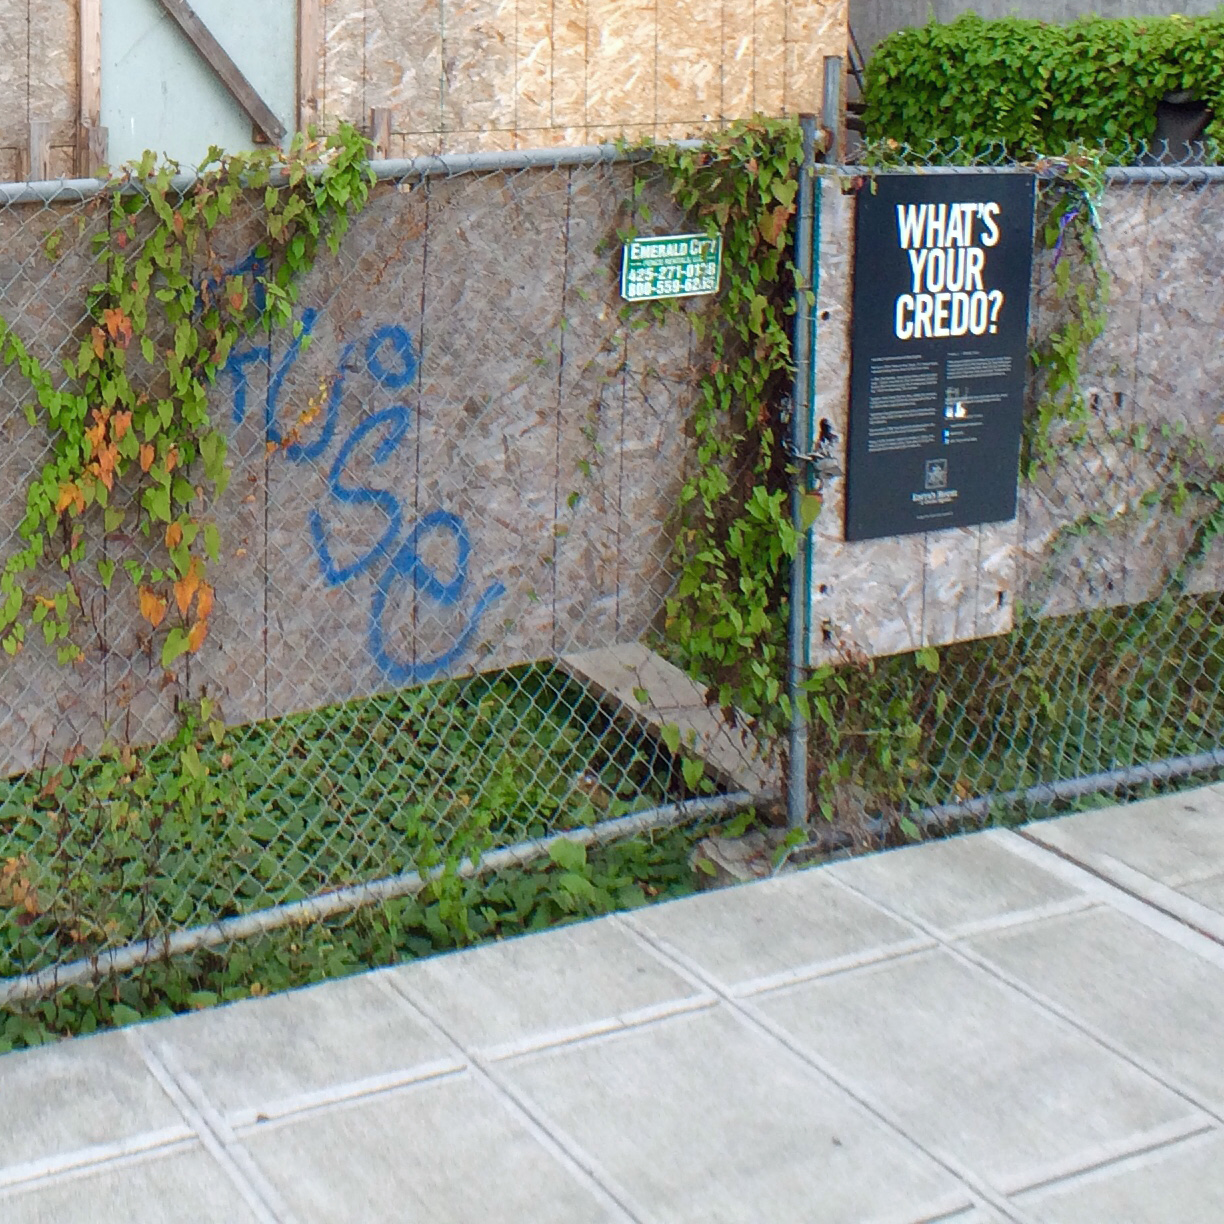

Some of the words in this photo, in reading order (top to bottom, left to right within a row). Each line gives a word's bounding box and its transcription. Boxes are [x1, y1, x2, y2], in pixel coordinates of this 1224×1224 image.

[896, 202, 1001, 249] WHAT'S
[908, 247, 985, 294] YOUR
[895, 290, 1004, 340] CREDO?
